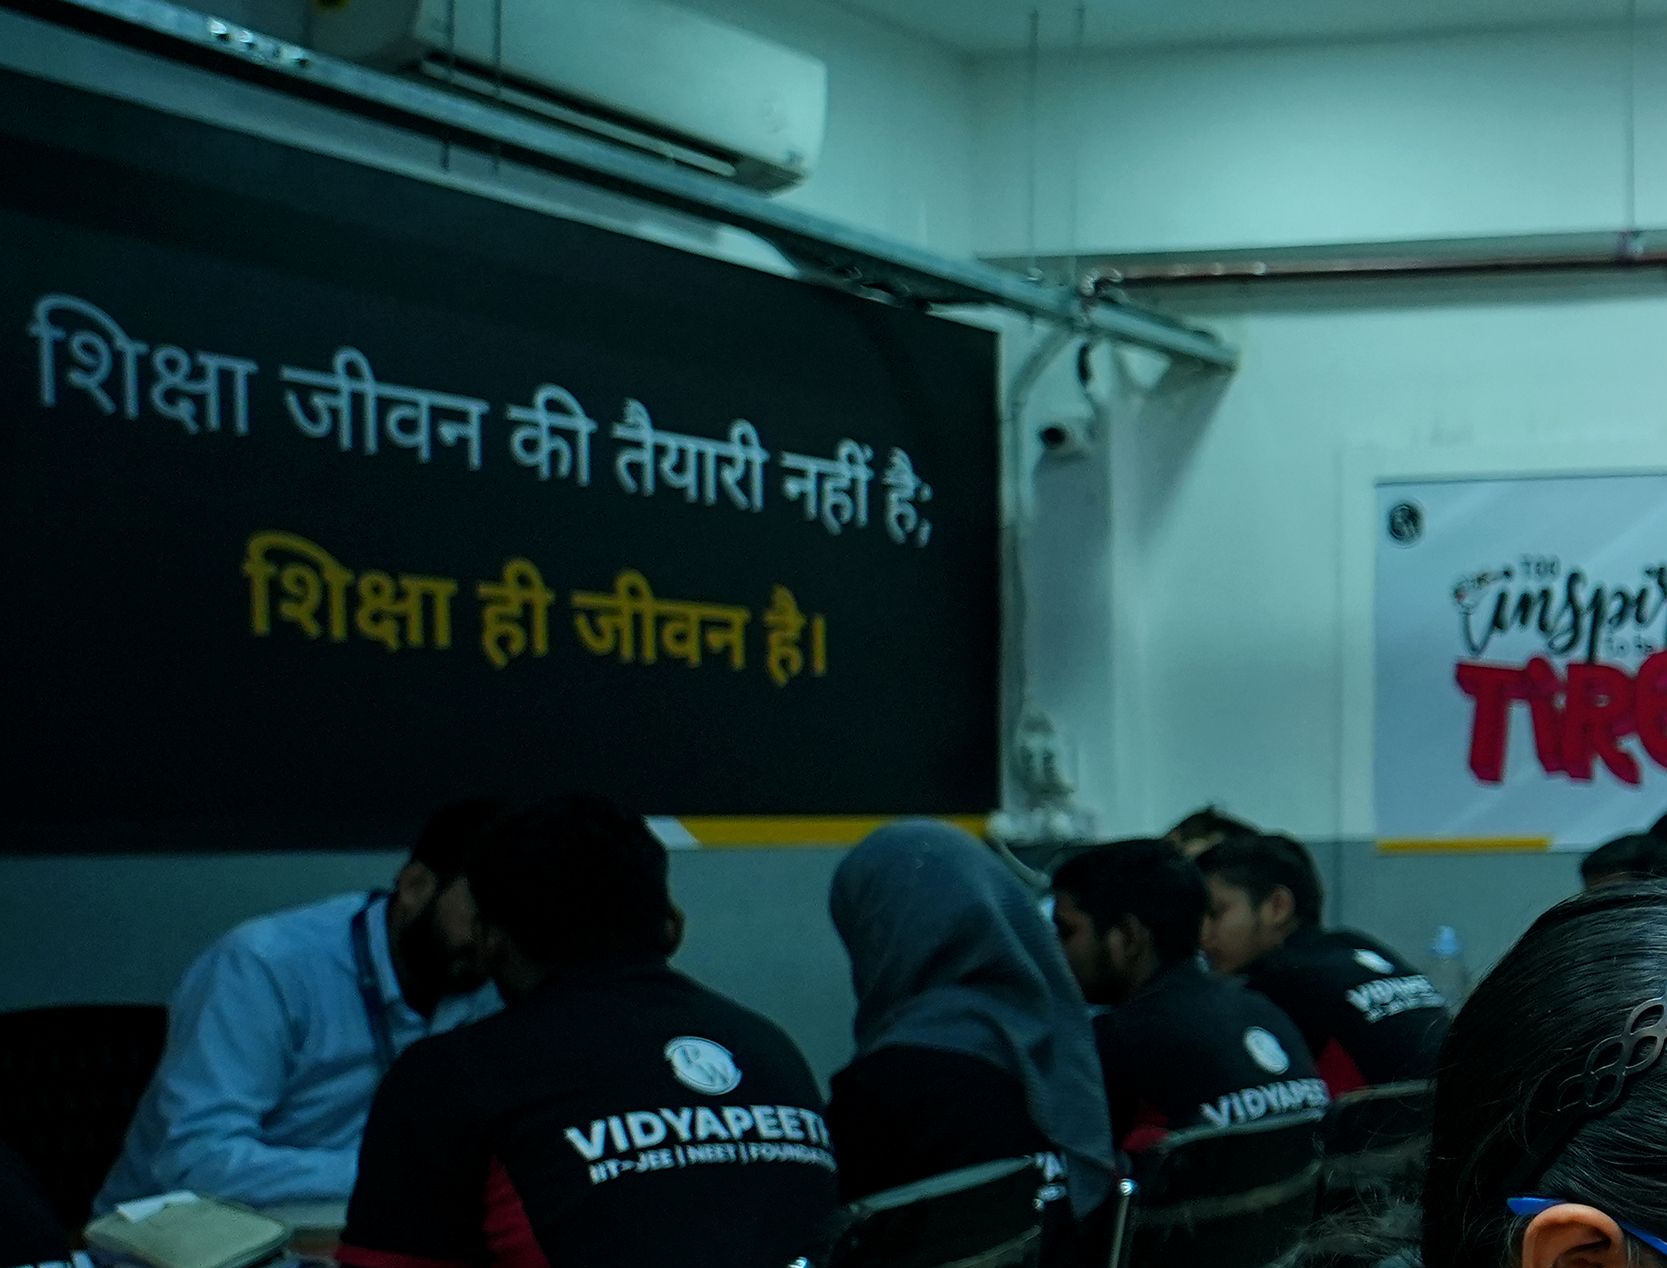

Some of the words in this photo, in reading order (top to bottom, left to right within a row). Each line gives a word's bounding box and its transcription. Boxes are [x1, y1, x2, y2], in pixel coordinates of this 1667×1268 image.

[29, 293, 257, 435] शिक्षा
[280, 347, 489, 470] जीवन
[507, 384, 597, 486] की
[613, 398, 767, 514] तैयारी
[780, 437, 872, 536] नहीं
[242, 530, 456, 652] शिक्षा
[478, 558, 555, 671] ही
[572, 569, 751, 672] जीवन
